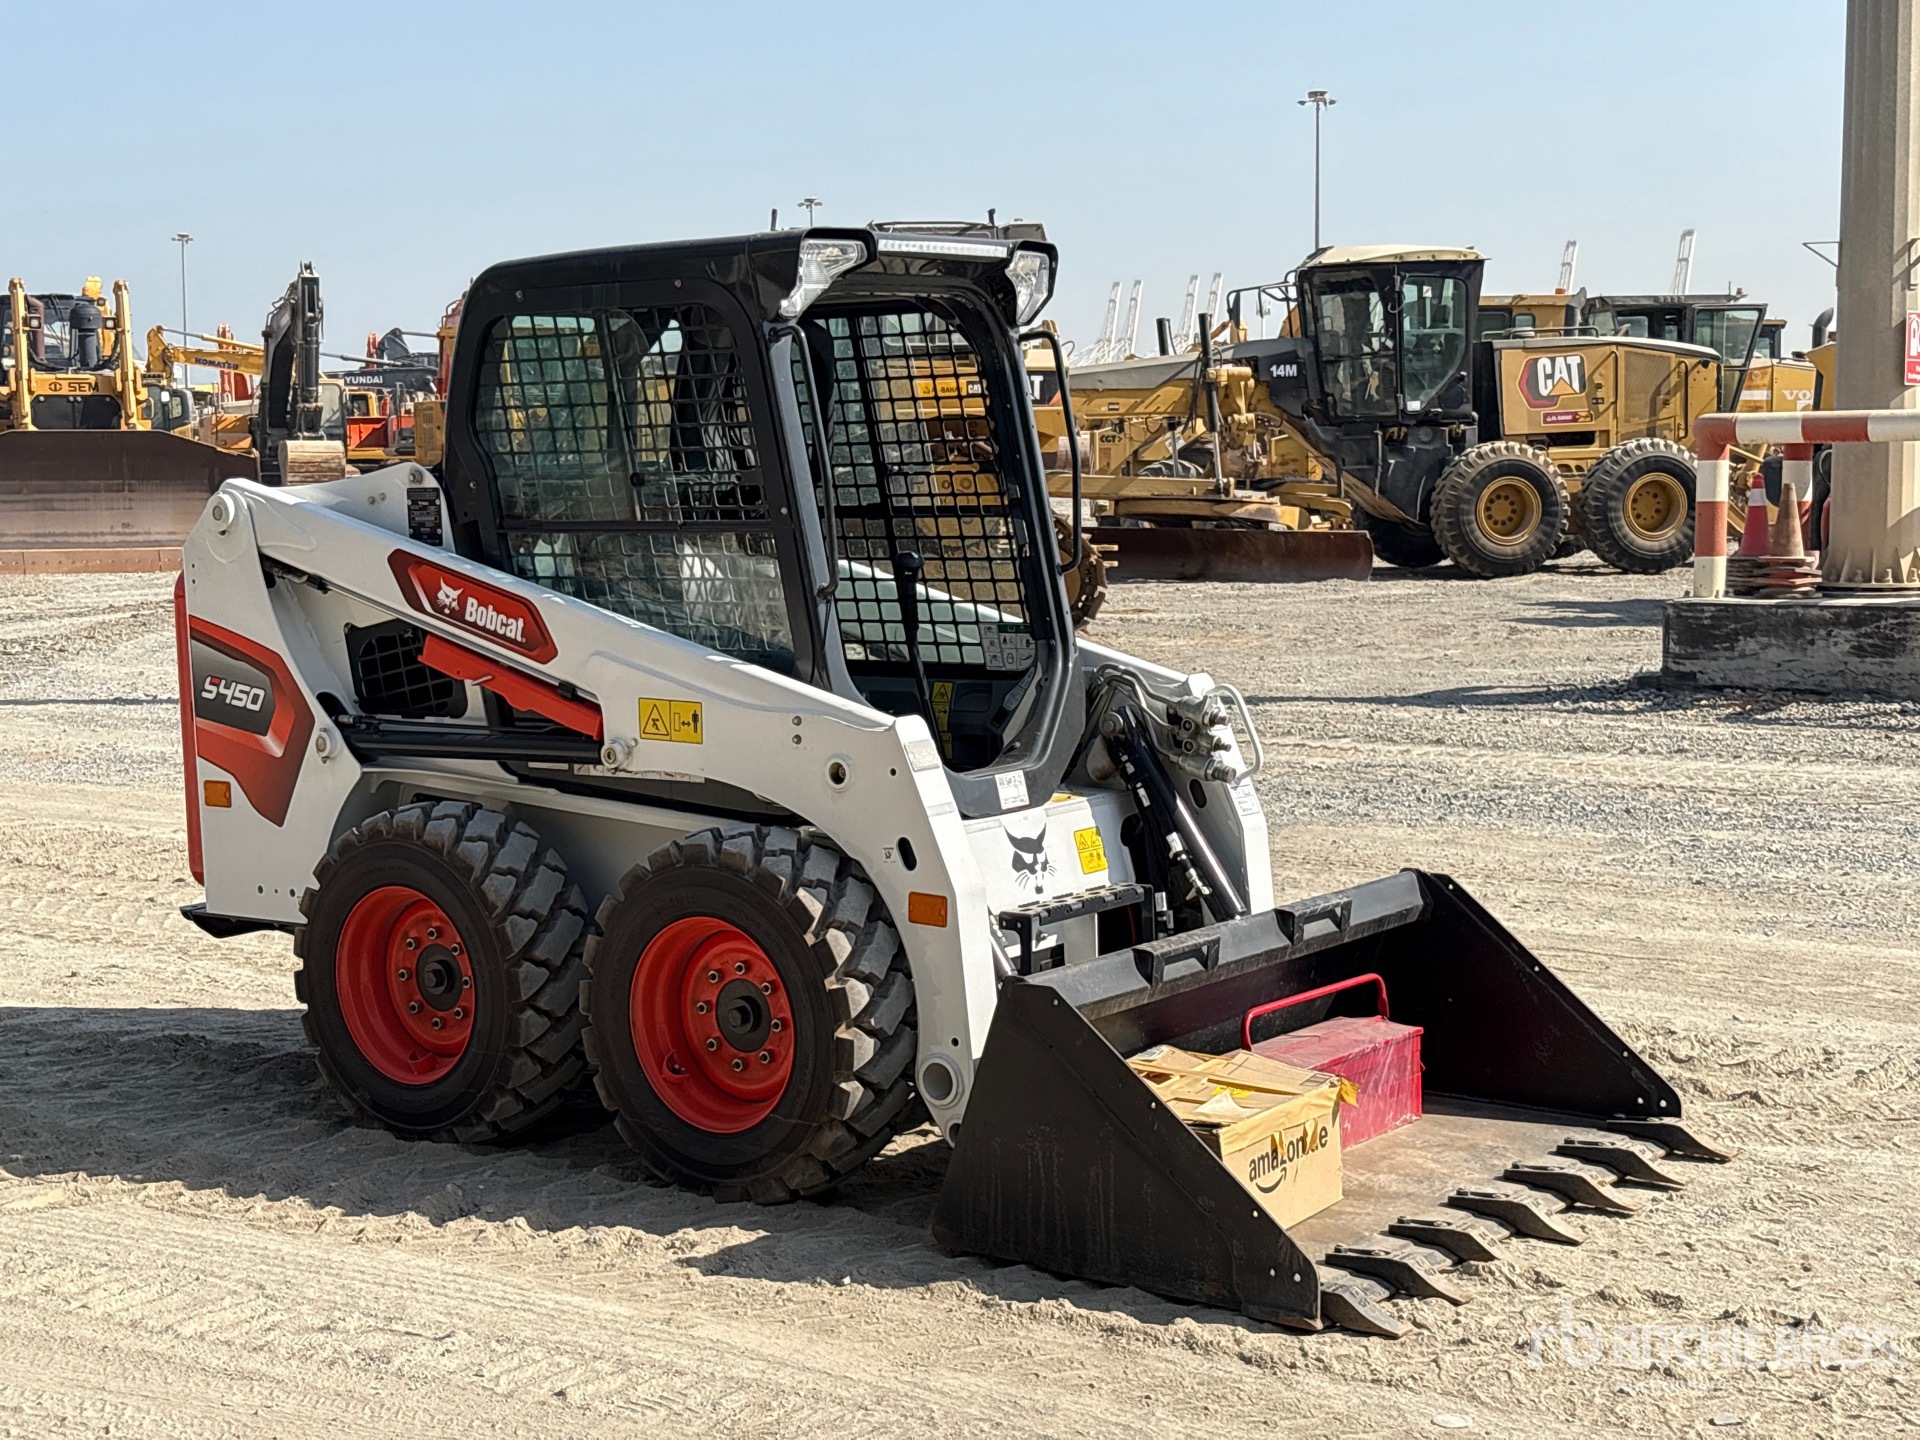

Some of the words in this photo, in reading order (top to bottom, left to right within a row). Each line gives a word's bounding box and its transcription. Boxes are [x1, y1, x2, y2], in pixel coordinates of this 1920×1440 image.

[194, 357, 239, 371] KOMATSU
[1269, 364, 1298, 378] 14M
[343, 375, 384, 384] YUNDAI
[1537, 355, 1581, 397] CAT
[67, 381, 99, 393] SEM
[464, 596, 525, 643] Bobcat
[201, 676, 265, 712] S450
